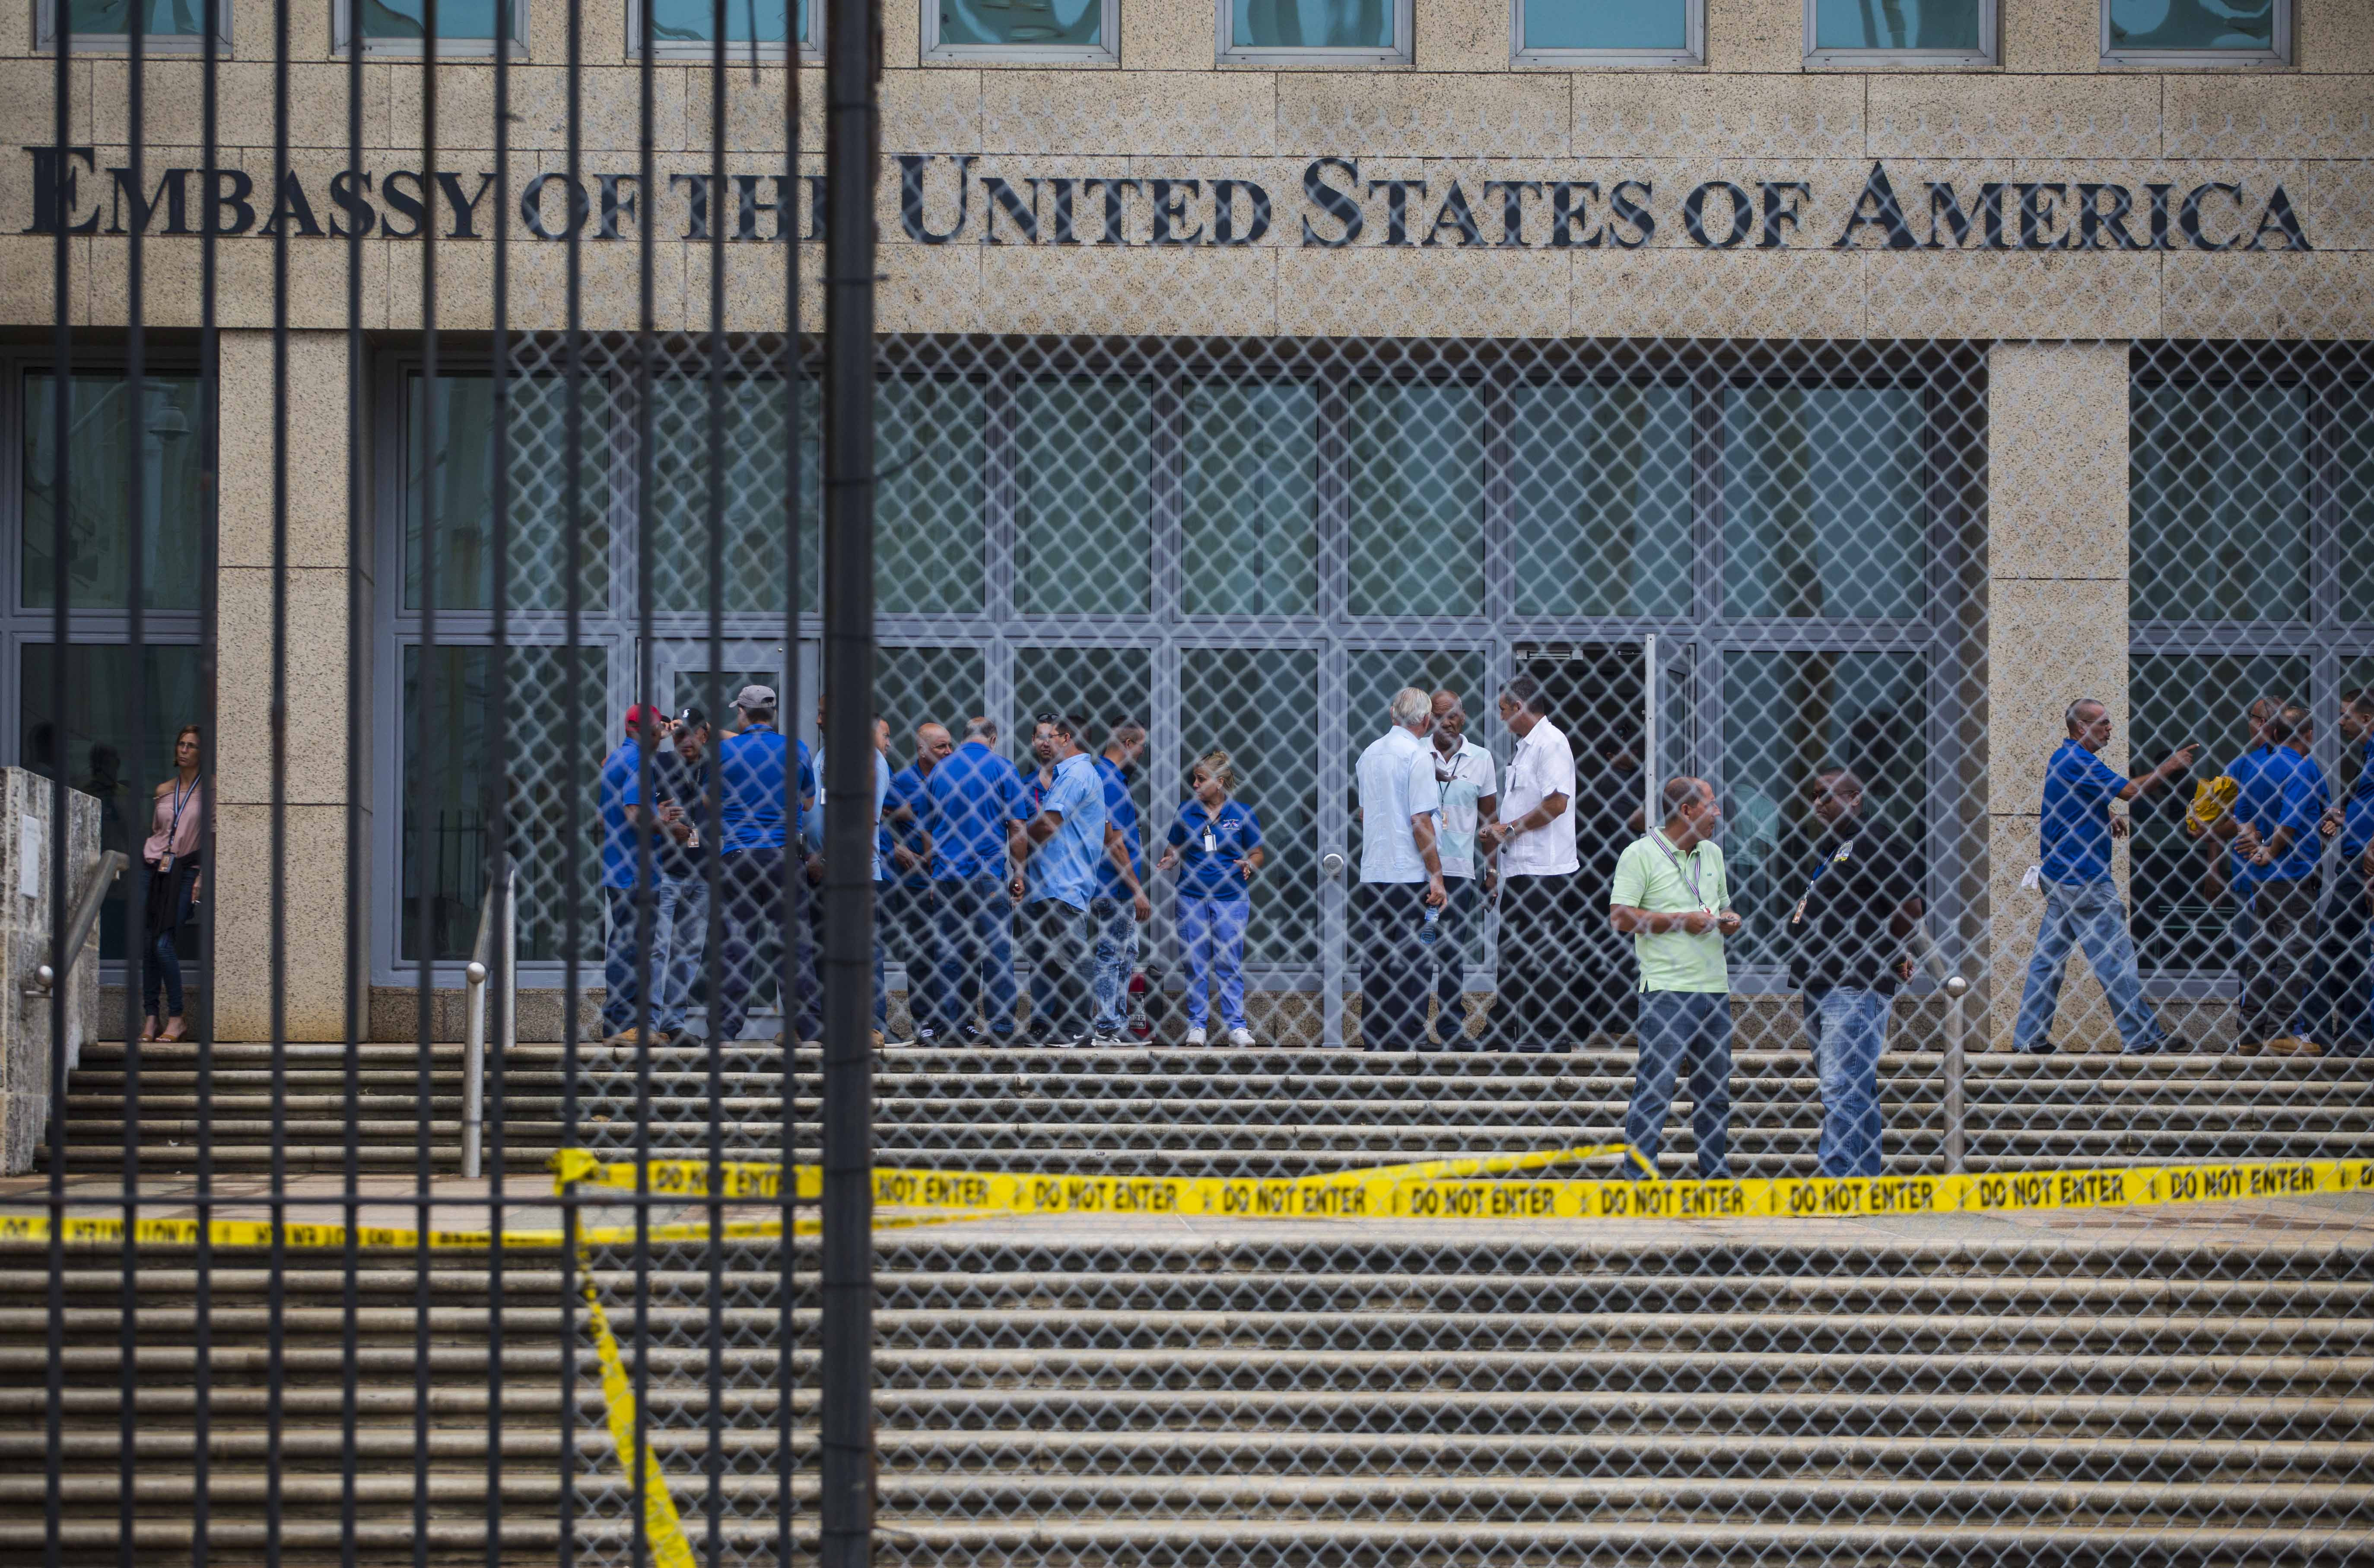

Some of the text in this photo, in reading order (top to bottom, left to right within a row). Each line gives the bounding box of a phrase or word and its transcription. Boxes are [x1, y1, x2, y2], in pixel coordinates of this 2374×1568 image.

[22, 146, 500, 238] EMBASSY
[521, 173, 644, 240] OF
[891, 156, 1271, 244] UNITED
[1303, 157, 1655, 249] STATES
[1685, 181, 1810, 249] OF
[1832, 160, 2313, 252] AMERICA
[925, 1175, 988, 1204] ENTER
[1035, 1181, 1177, 1210] DO NOT ENTER
[1980, 1174, 2124, 1207] DO NOT ENTER
[2170, 1165, 2314, 1199] DO NOT ENTER
[1224, 1184, 1366, 1213] DO NOT ENTER
[1411, 1187, 1554, 1215] DO NOT ENTER
[1602, 1186, 1744, 1214] DO NOT ENTER
[1789, 1181, 1933, 1213] DO NOT ENTER
